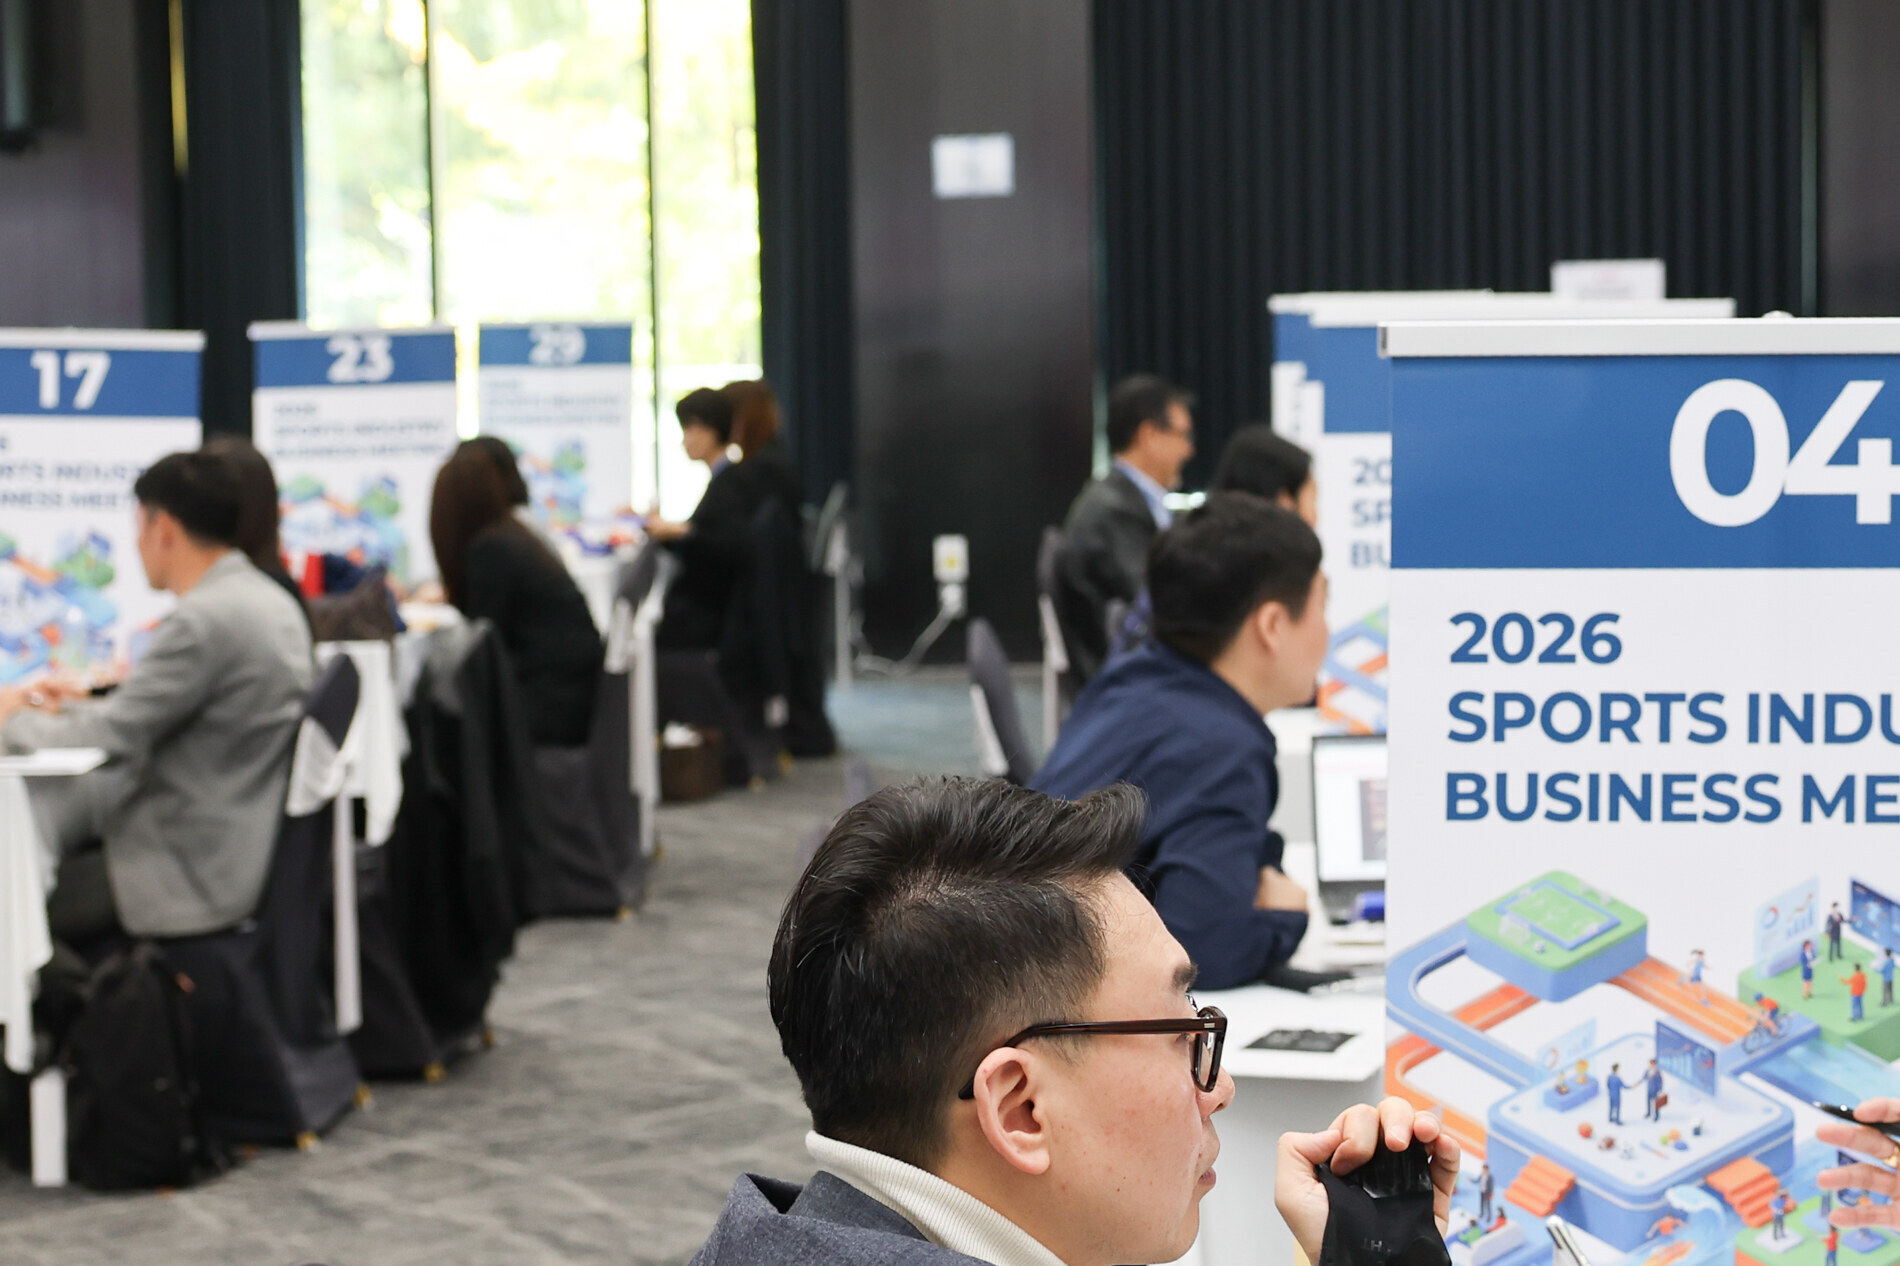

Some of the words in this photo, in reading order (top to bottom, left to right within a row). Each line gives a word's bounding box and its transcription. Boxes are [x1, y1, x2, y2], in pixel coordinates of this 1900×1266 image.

[30, 350, 112, 410] 17
[326, 334, 395, 385] 23
[1450, 612, 1622, 664] 2026
[1448, 691, 1727, 744] SPORTS
[1446, 772, 1781, 824] BUSINESS
